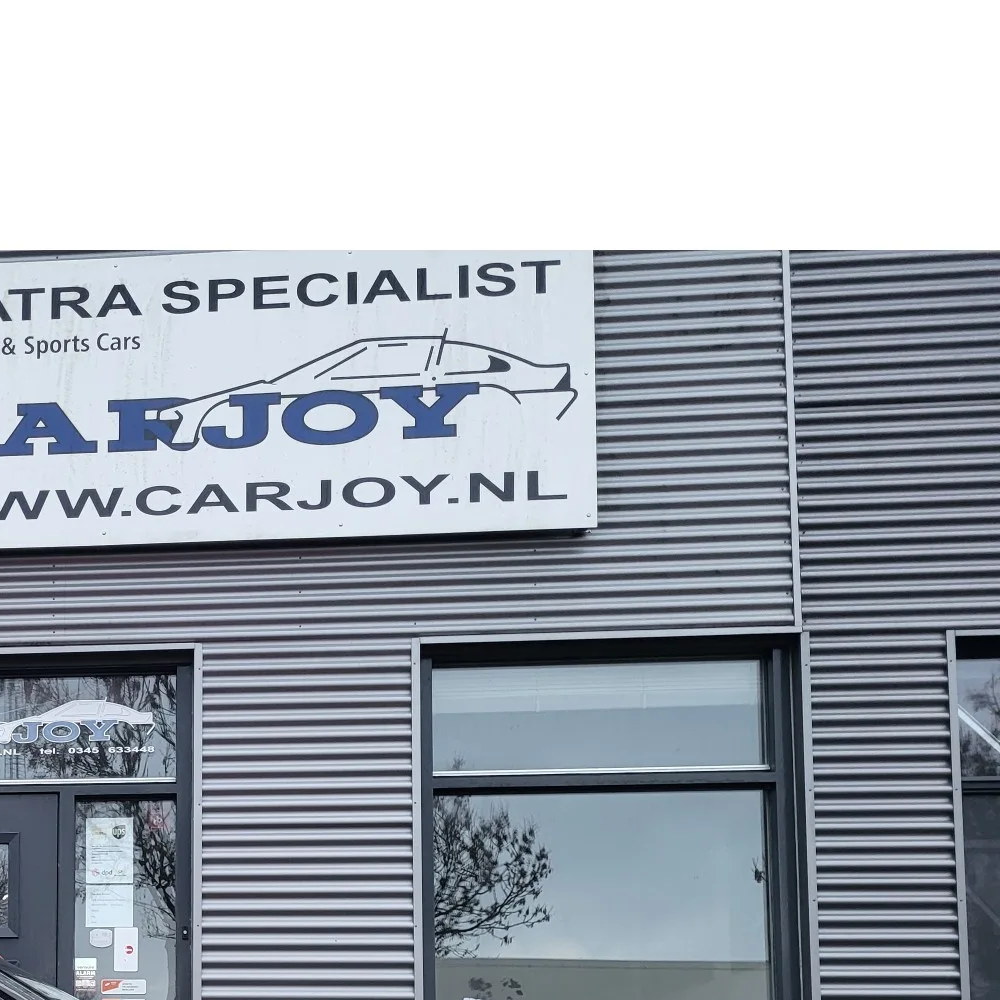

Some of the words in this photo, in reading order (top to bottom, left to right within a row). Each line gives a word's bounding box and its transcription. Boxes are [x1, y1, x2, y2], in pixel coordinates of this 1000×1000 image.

[161, 259, 561, 315] SPECIALIST
[1, 337, 16, 356] &
[24, 335, 90, 360] Sports
[96, 332, 141, 352] Cars
[67, 746, 100, 755] 0345
